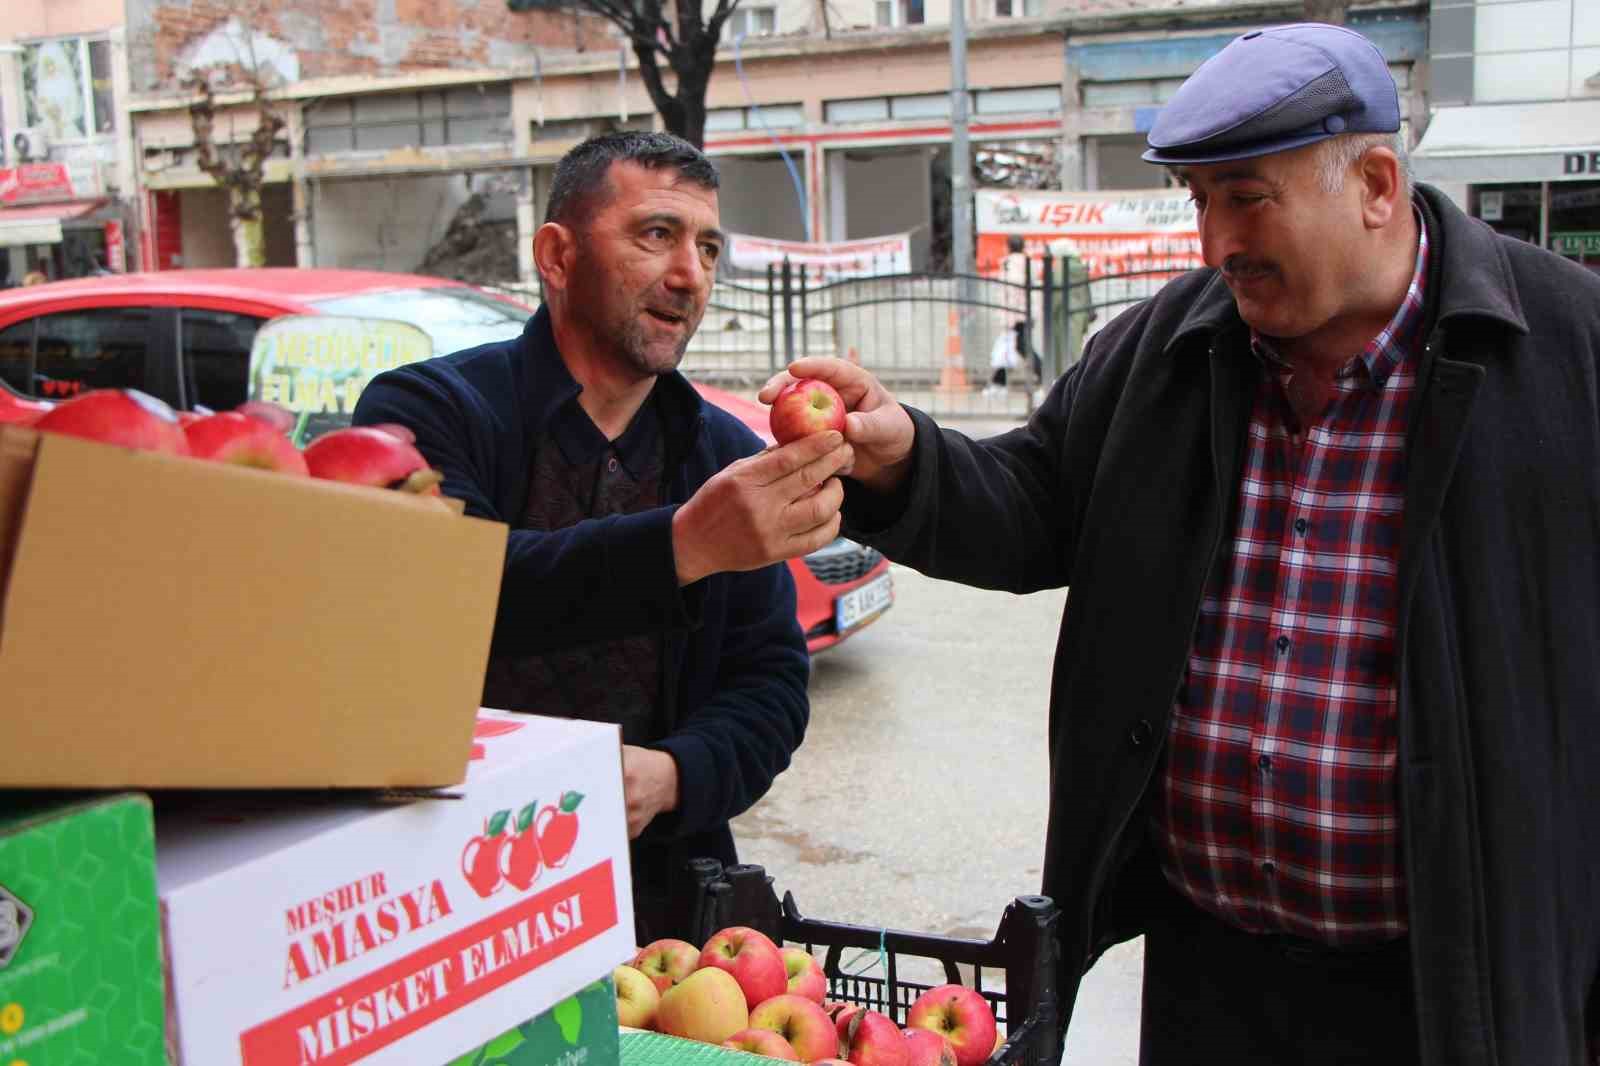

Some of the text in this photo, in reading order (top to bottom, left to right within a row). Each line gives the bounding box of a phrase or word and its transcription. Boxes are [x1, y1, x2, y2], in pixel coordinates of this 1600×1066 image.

[1039, 203, 1107, 227] IŞIK
[281, 879, 454, 989] AMASYA
[285, 871, 388, 935] MEŞHUR
[297, 894, 585, 1066] MİSKET ELMASI
